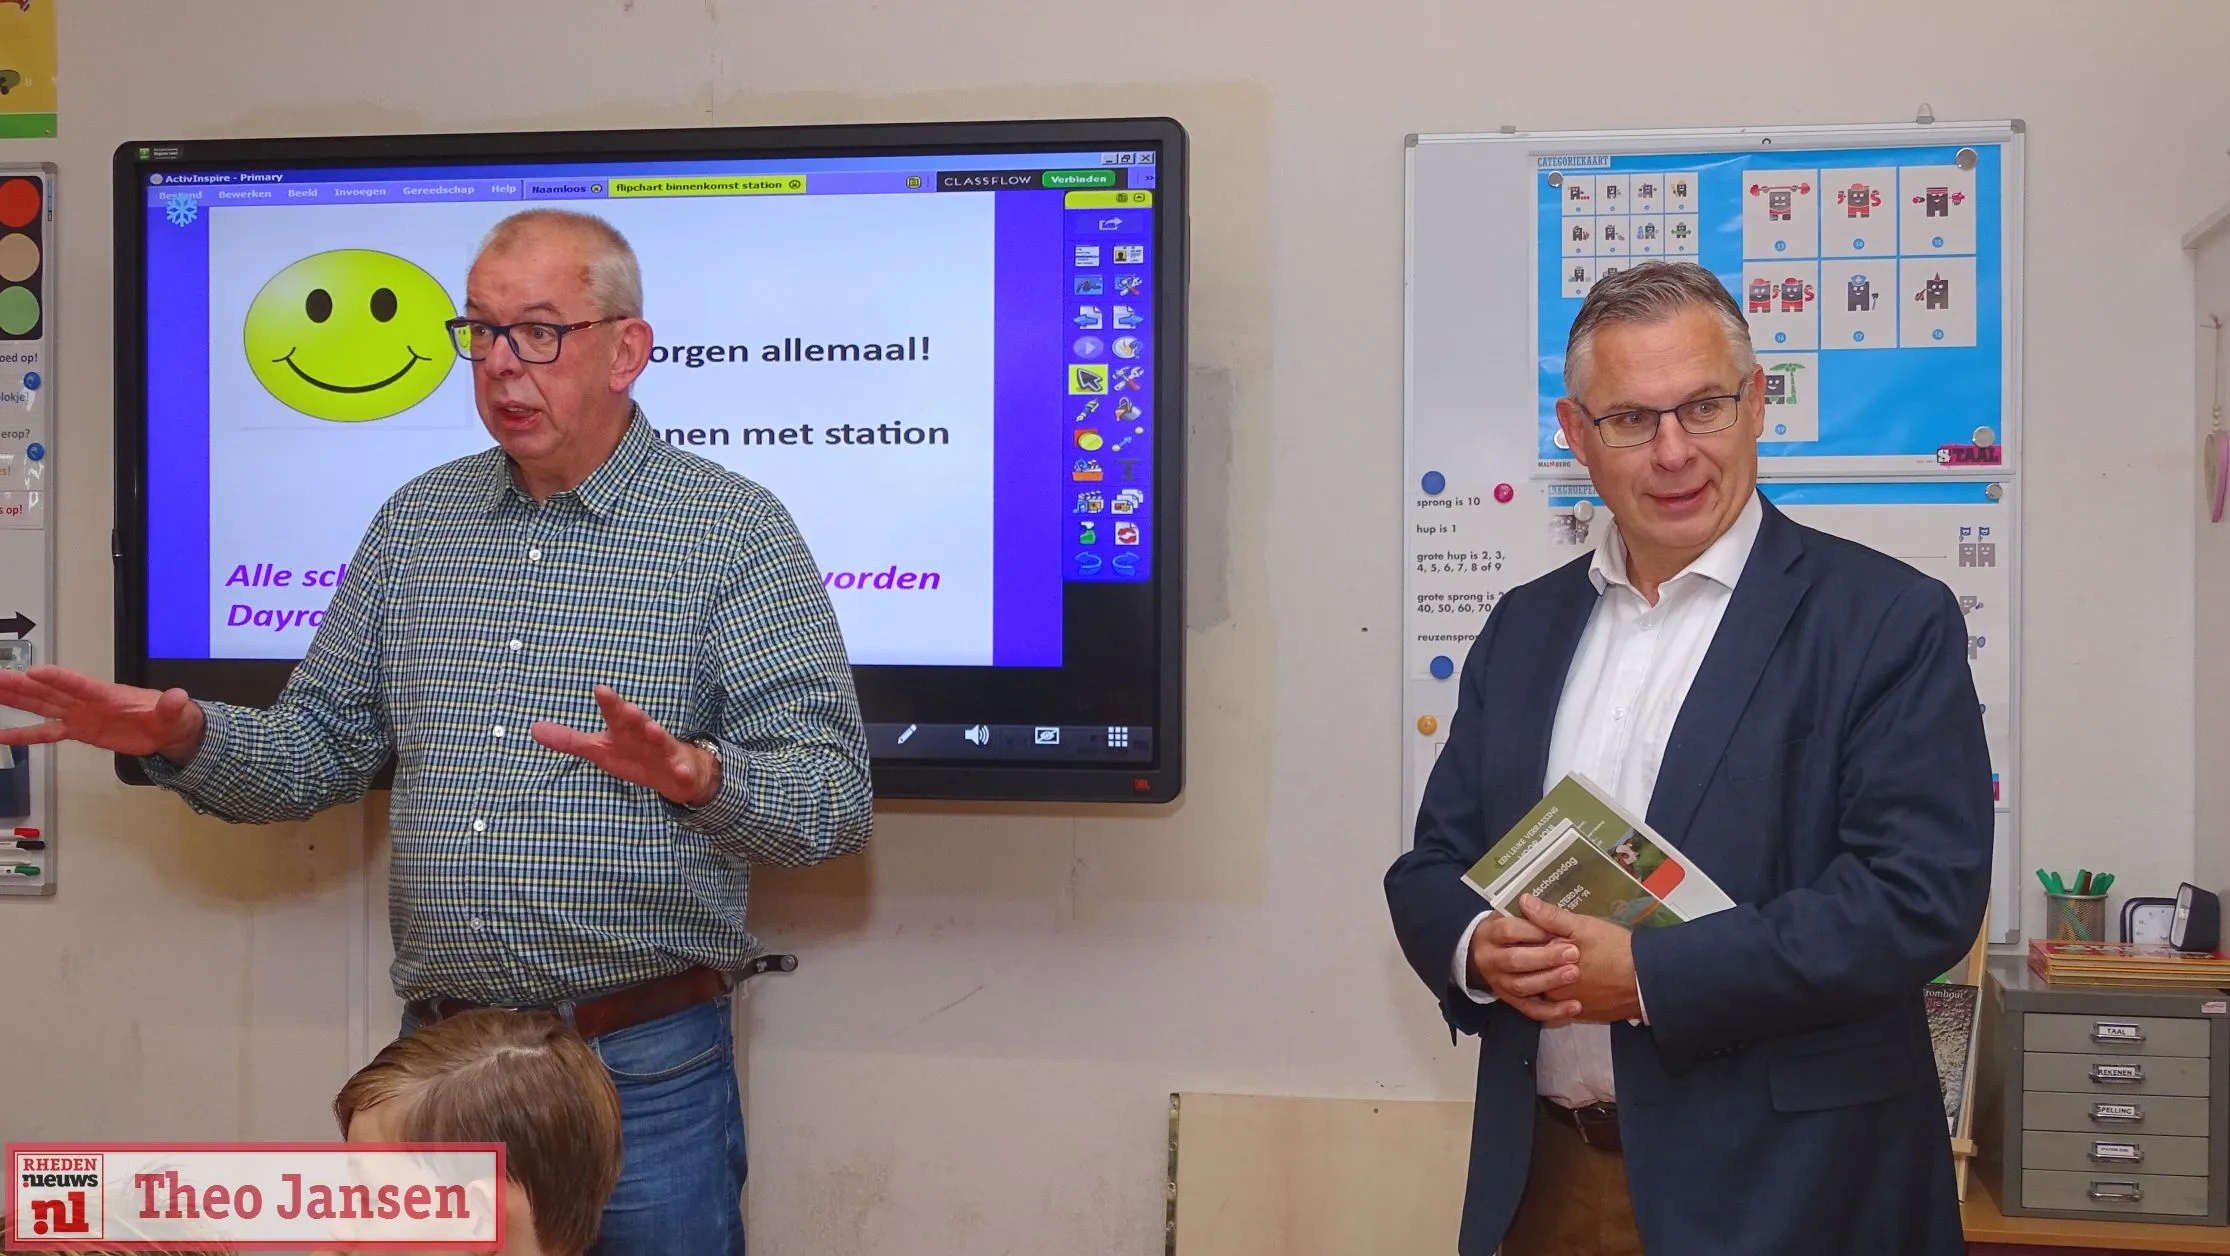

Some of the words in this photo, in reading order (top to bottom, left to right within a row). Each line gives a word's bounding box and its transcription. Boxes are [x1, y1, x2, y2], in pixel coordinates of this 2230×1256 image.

[1537, 155, 1609, 167] CATEGORIEKAART
[165, 174, 231, 184] ActivInspire
[240, 173, 284, 183] Primary
[943, 174, 1032, 187] CLASSFLOW
[1050, 174, 1107, 184] Verbinden
[402, 185, 475, 196] Gereedschap
[491, 184, 517, 194] Help
[532, 184, 586, 194] Naamloos
[616, 182, 664, 193] flipchart
[665, 181, 740, 192] binnenkomst
[742, 180, 782, 190] station
[218, 189, 273, 199] Bewerken
[287, 188, 319, 198] Beeld
[334, 188, 387, 197] Invoegen
[761, 336, 930, 363] allemaal!
[21, 353, 38, 365] op!
[1, 429, 31, 440] erop?
[743, 423, 814, 446] met
[825, 421, 949, 446] station
[1416, 498, 1452, 509] sprong
[1455, 497, 1463, 506] is
[1468, 497, 1480, 506] 10
[6, 504, 23, 517] op!
[1416, 524, 1436, 536] hup
[1439, 524, 1447, 533] is
[1451, 524, 1456, 533] 1
[1416, 552, 1444, 563] grote
[1447, 550, 1467, 562] hup
[1470, 551, 1478, 560] is
[1482, 551, 1491, 561] 2,
[1495, 551, 1505, 561] 3,
[1416, 563, 1427, 573] 4,
[1430, 563, 1440, 573] 5,
[1444, 563, 1454, 573] 6,
[1457, 563, 1467, 573] 7,
[1471, 563, 1478, 572] 8
[1481, 562, 1492, 572] of
[1494, 562, 1502, 571] 9
[225, 563, 292, 588] Alle
[1417, 593, 1444, 604] grote
[1447, 593, 1483, 603] sprong
[1486, 591, 1494, 601] is
[1417, 603, 1434, 613] 40,
[1437, 603, 1454, 613] 50,
[1458, 603, 1475, 613] 60,
[1498, 852, 1511, 866] EEN
[1508, 838, 1527, 856] LEUKE
[1524, 806, 1559, 839] VERRASSING
[2098, 1069, 2133, 1077] REKENEN
[2097, 1106, 2132, 1115] SPELLING
